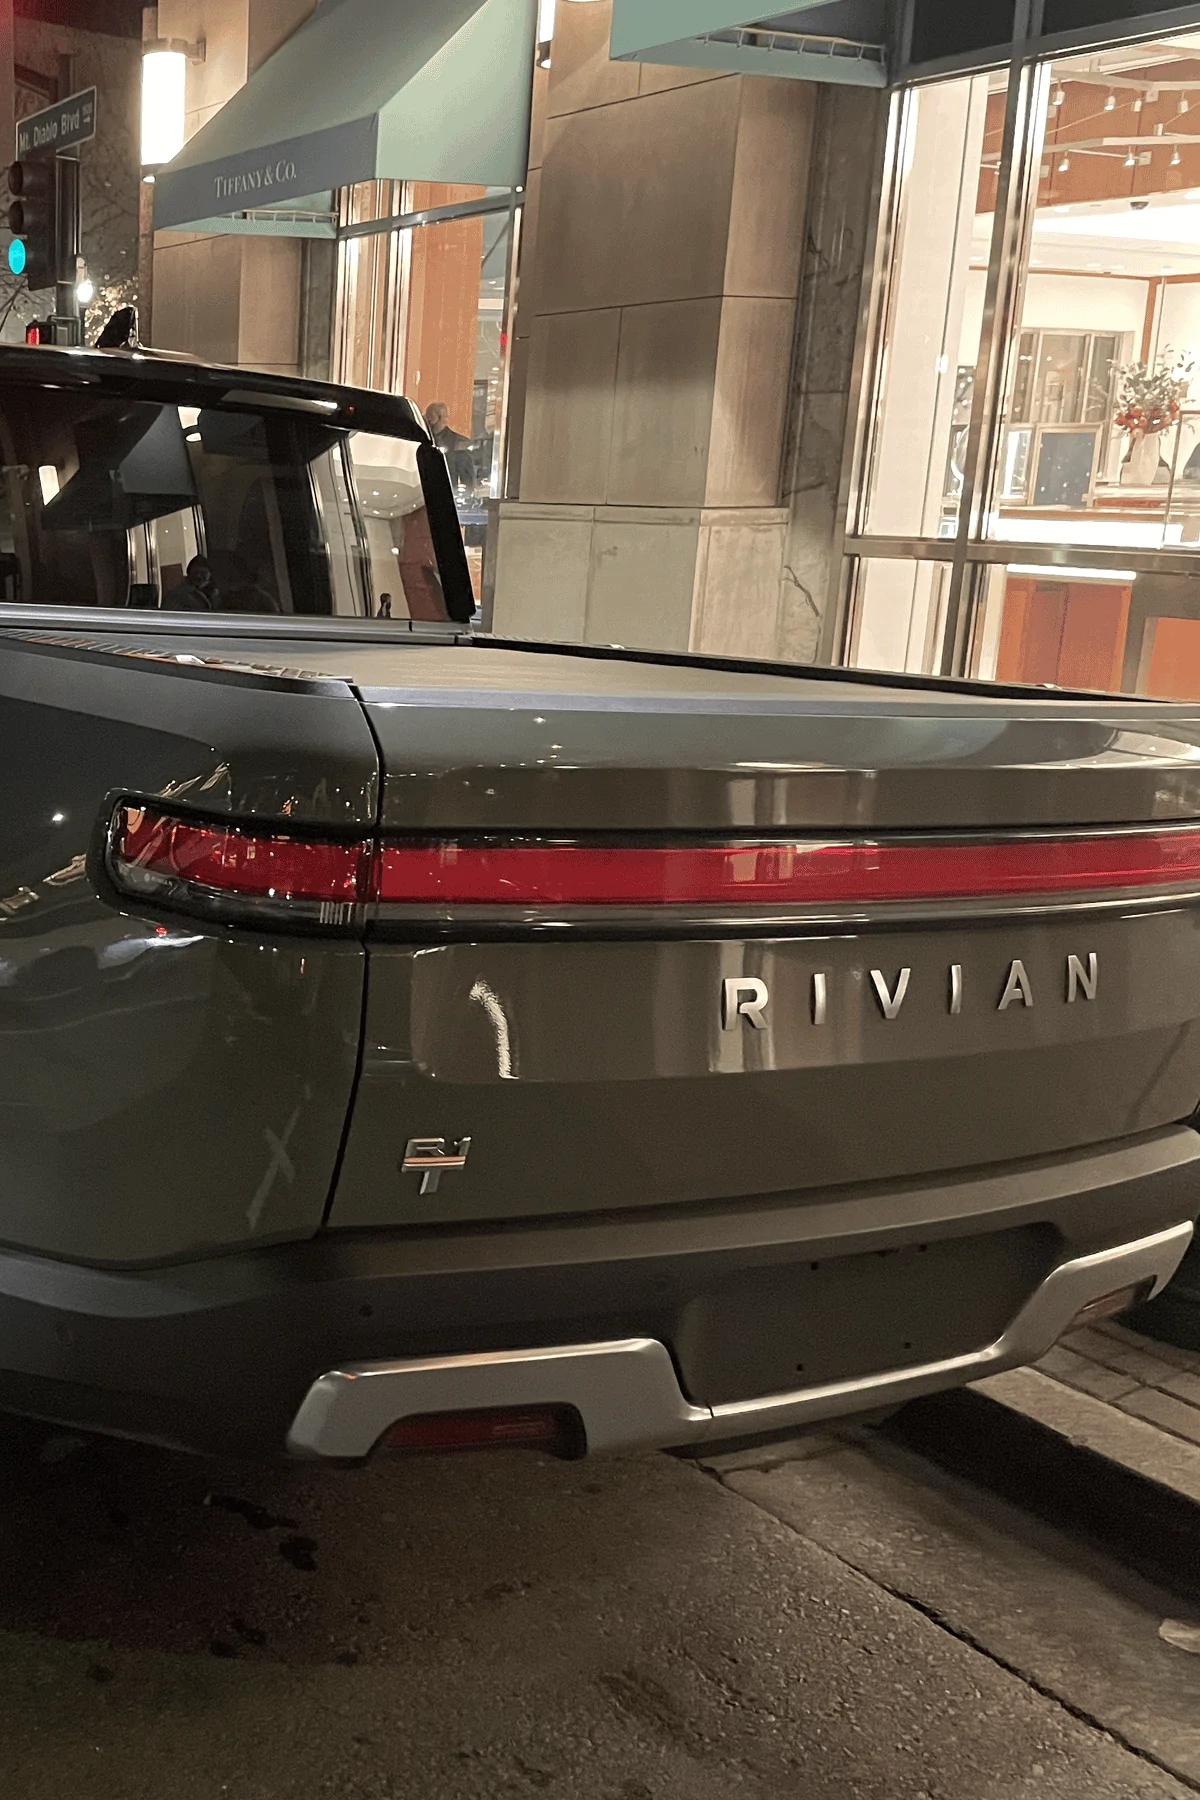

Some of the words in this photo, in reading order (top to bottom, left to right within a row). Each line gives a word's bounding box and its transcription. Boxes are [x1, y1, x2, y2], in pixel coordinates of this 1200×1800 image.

[33, 121, 58, 147] Diablo
[61, 107, 80, 135] Blvd
[722, 952, 1098, 1031] RIVIAN
